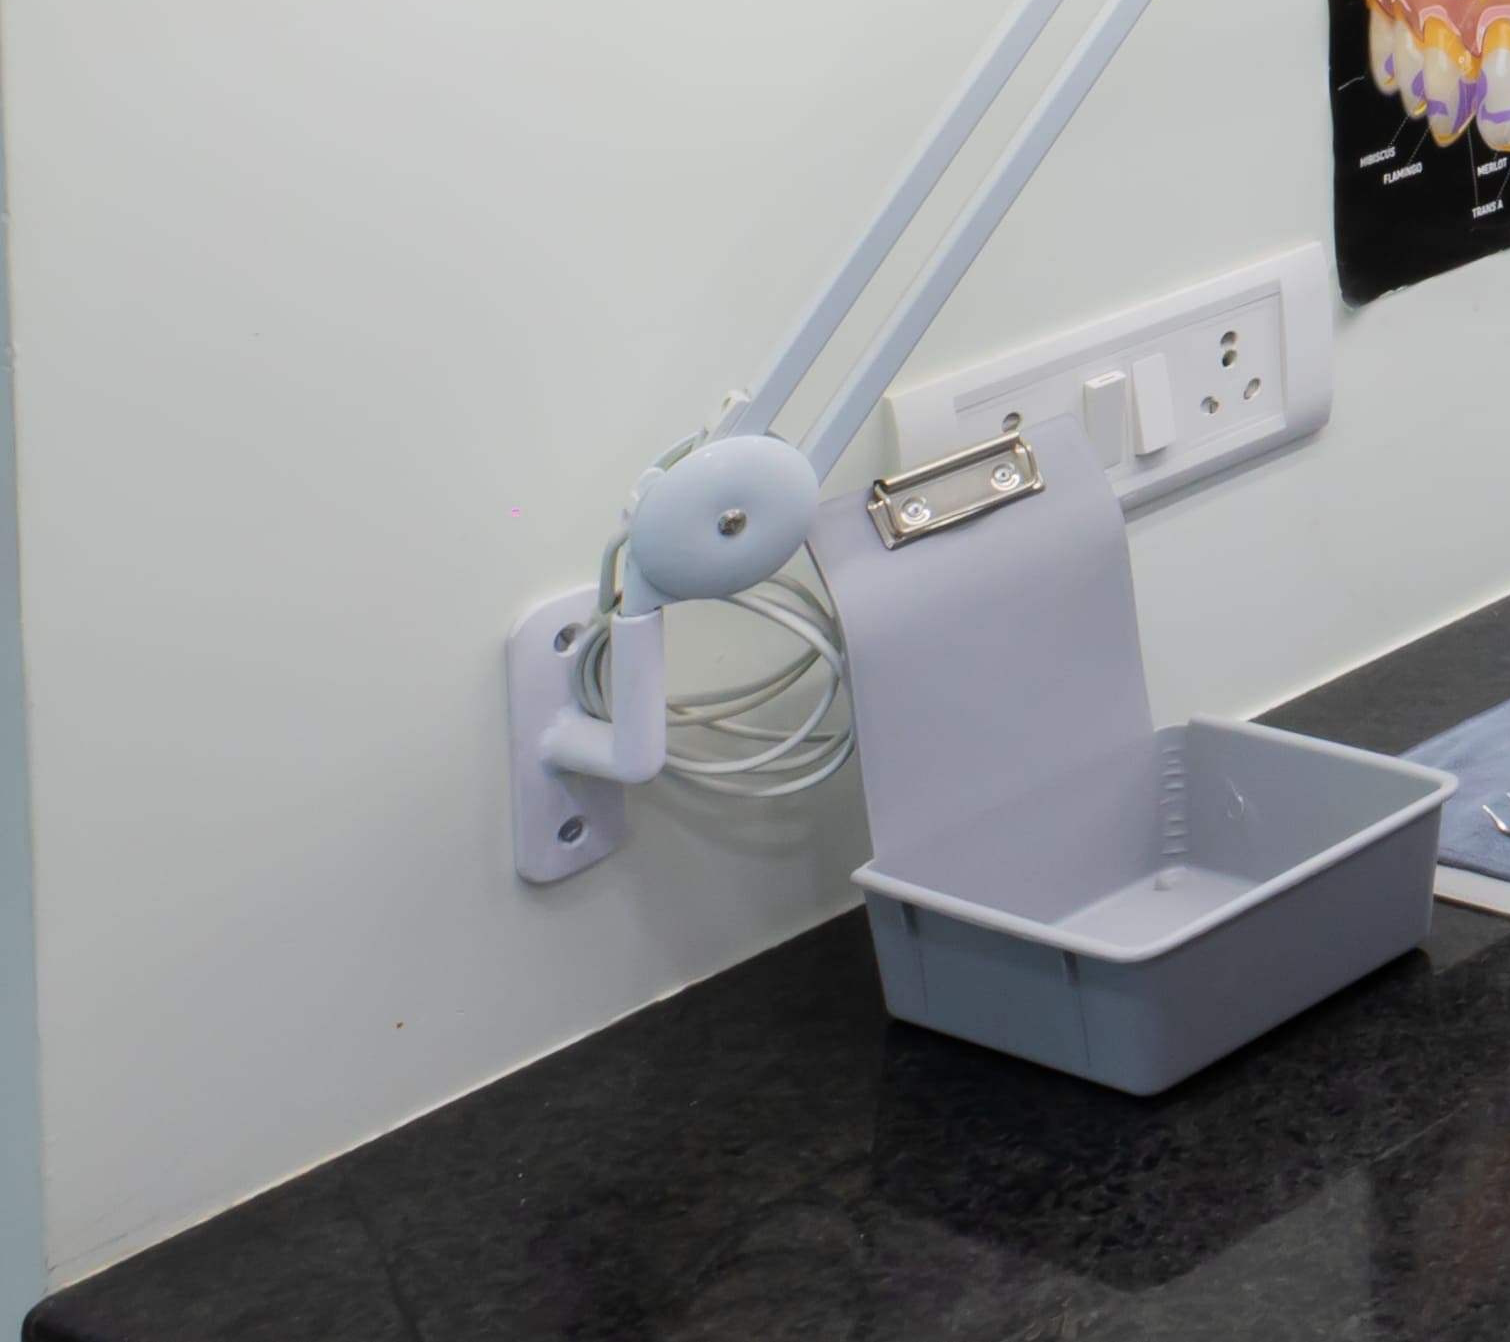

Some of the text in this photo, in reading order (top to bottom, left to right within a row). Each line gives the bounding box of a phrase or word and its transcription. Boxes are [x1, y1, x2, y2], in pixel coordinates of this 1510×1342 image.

[1360, 146, 1396, 168] HIBISCUS
[1477, 157, 1508, 177] MERLOT
[1383, 161, 1423, 185] FLAMINGO
[1472, 199, 1504, 219] TRANS A
